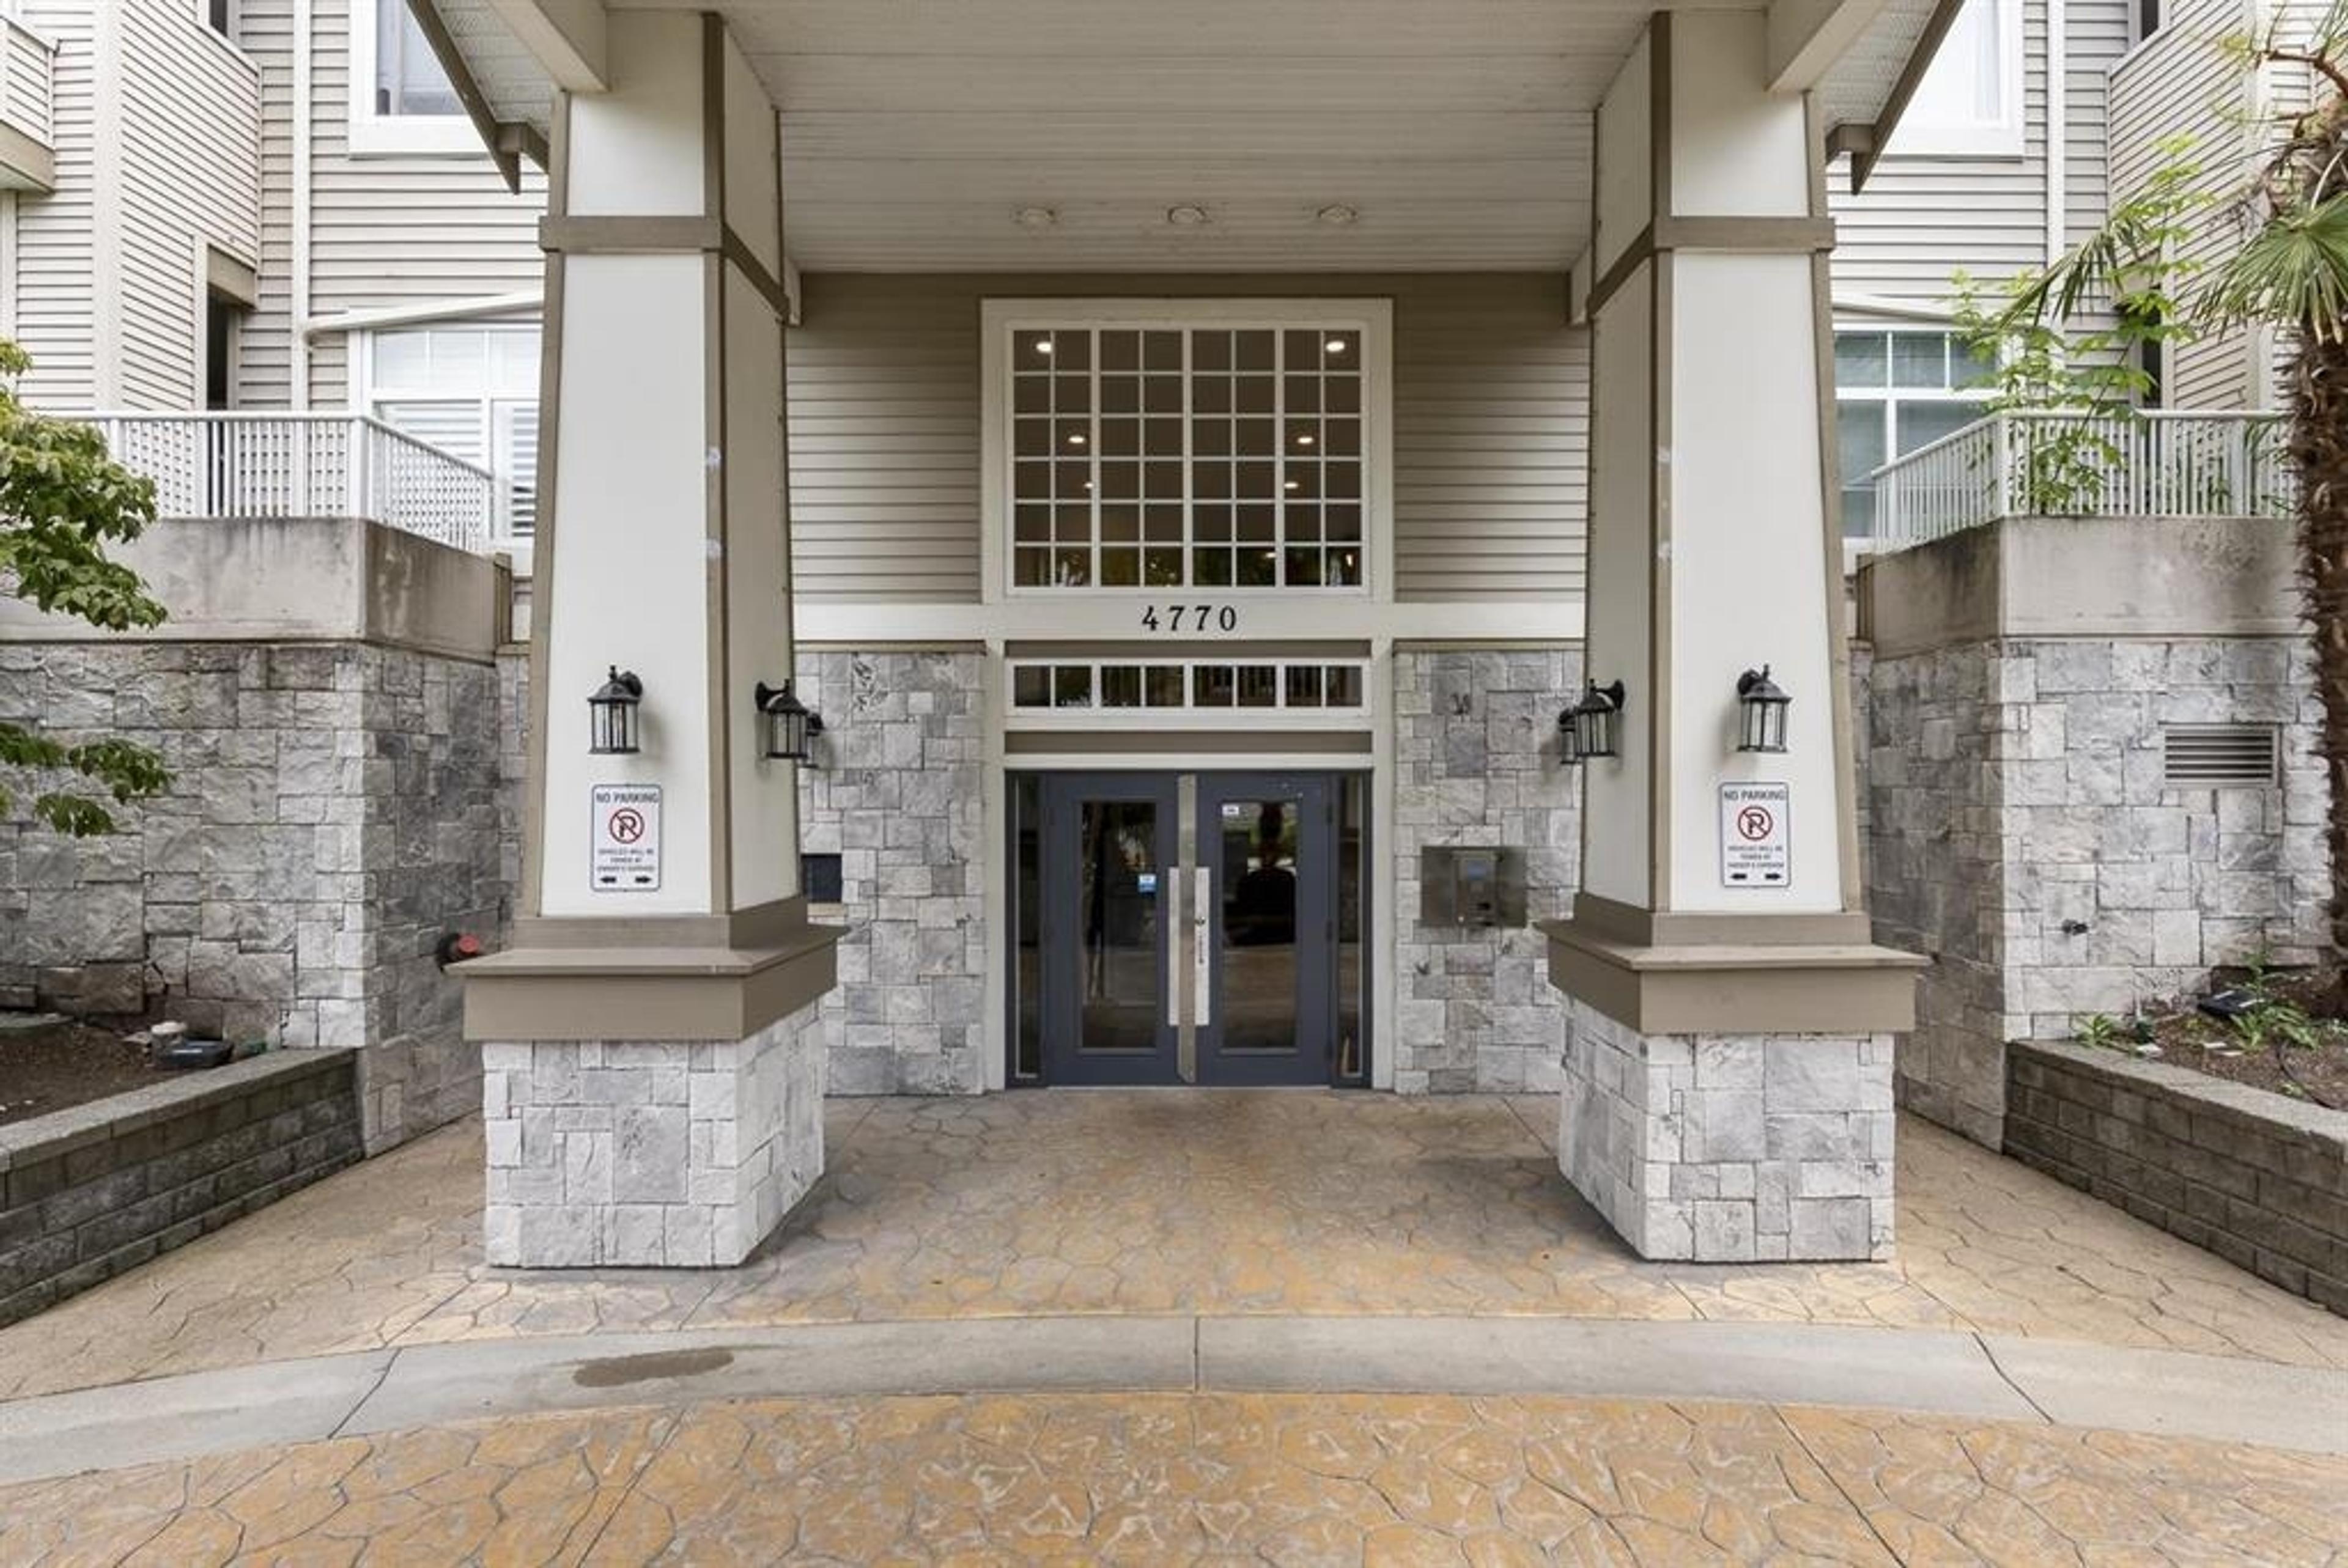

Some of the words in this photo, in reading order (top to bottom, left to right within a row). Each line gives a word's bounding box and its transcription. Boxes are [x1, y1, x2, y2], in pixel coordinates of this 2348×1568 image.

[1142, 605, 1236, 631] 4770
[596, 793, 610, 803] NO
[613, 793, 659, 803] PARKING
[1724, 790, 1738, 800] NO
[1741, 790, 1786, 800] PARKING
